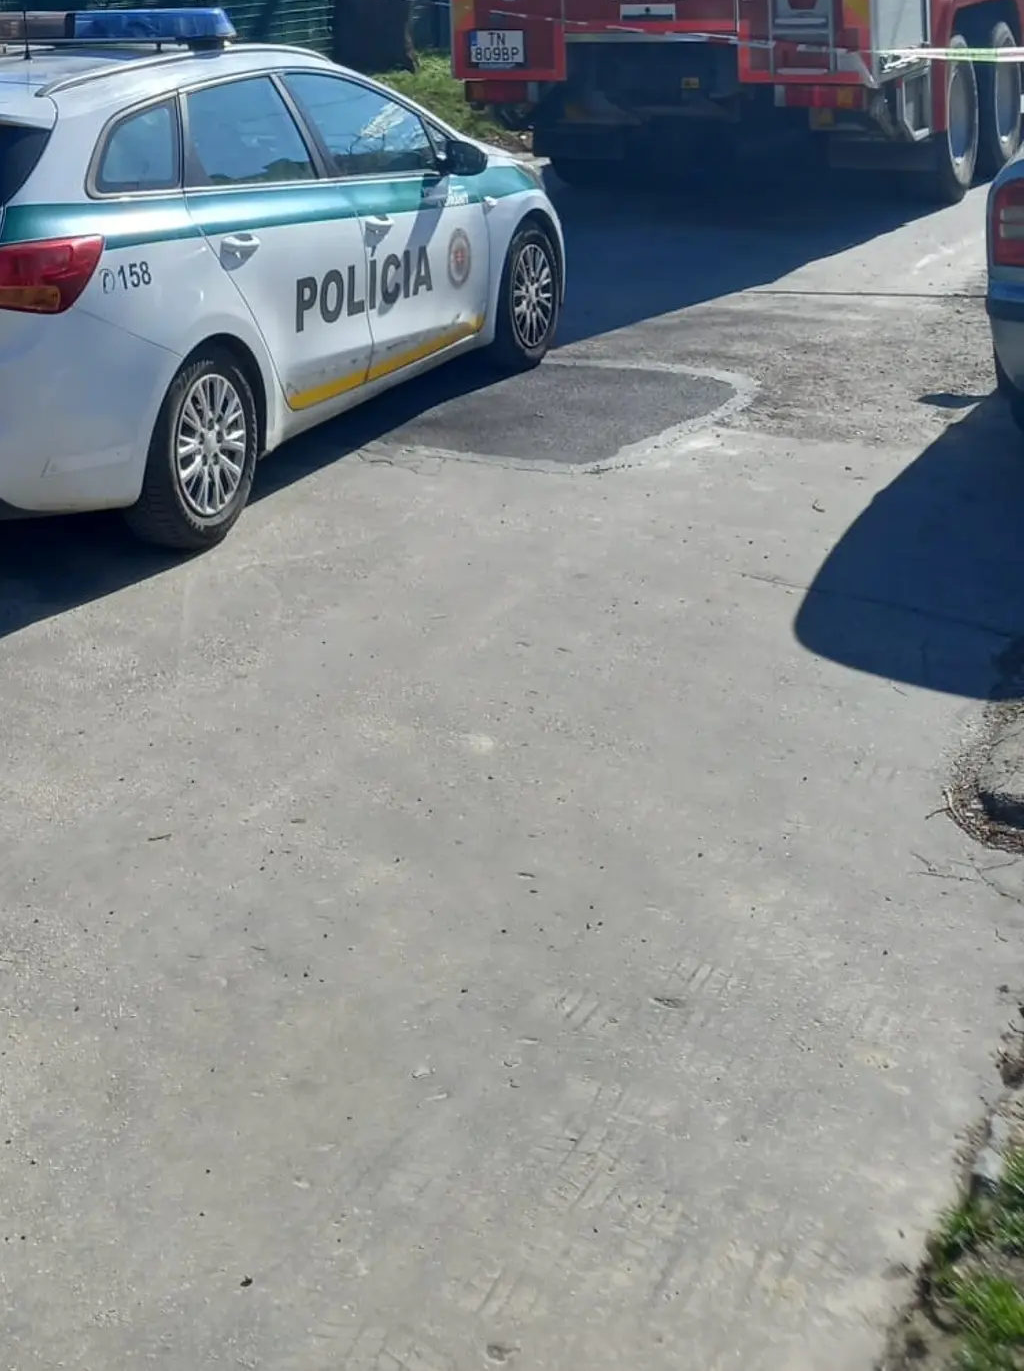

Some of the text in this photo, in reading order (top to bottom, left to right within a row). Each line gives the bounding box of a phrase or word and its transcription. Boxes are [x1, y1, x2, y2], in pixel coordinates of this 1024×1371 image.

[488, 32, 506, 46] TN
[117, 261, 153, 290] 158
[295, 245, 433, 332] POLÍCIA
